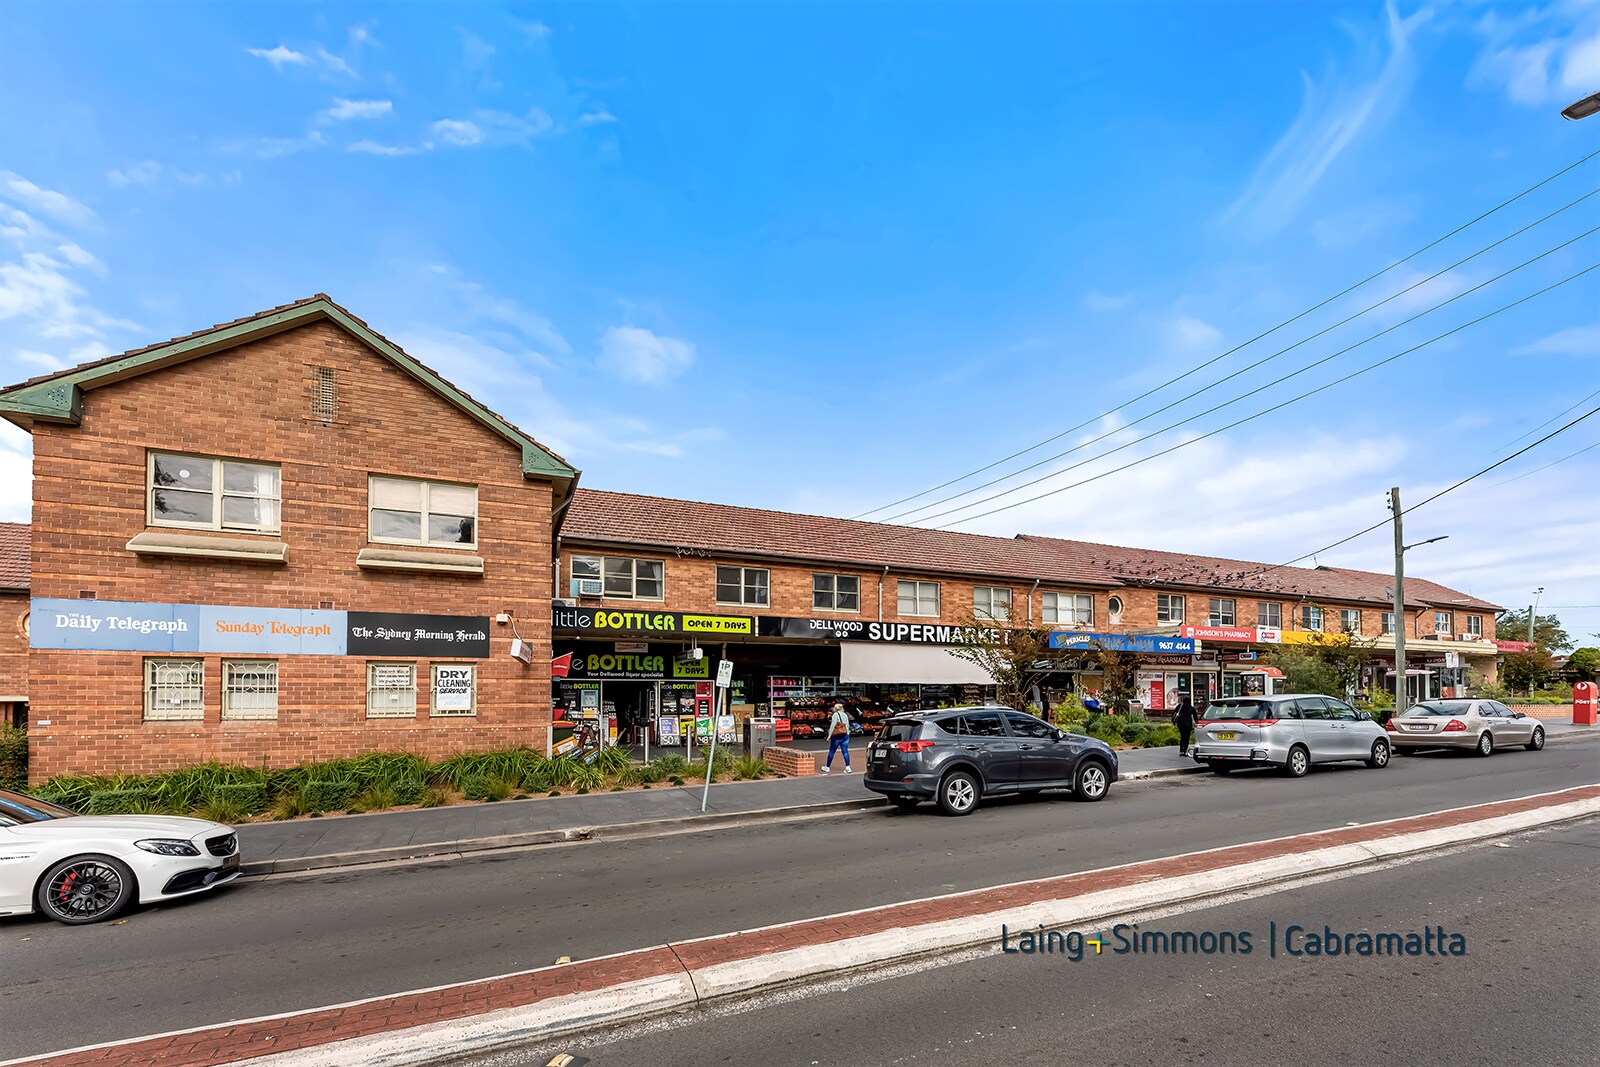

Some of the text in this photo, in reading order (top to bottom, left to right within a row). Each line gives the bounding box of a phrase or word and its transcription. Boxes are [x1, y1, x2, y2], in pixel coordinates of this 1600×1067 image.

[56, 615, 188, 635] Daily Telegraph
[594, 611, 675, 631] BOTTLER
[688, 619, 747, 630] OPEN 7 DAYS
[810, 619, 863, 632] DELLWOOD
[215, 620, 332, 637] Sunday Telegraph
[1194, 628, 1251, 639] JOHNSON'S PHARMACY
[352, 627, 486, 642] The Sydney Morning Herald
[1158, 641, 1173, 650] 9637
[587, 654, 664, 672] BOTTLER
[1157, 655, 1187, 665] PHARMACY
[686, 667, 705, 675] DAYS
[721, 661, 731, 671] 1P
[440, 670, 469, 679] DRY
[438, 679, 471, 688] CLEANING
